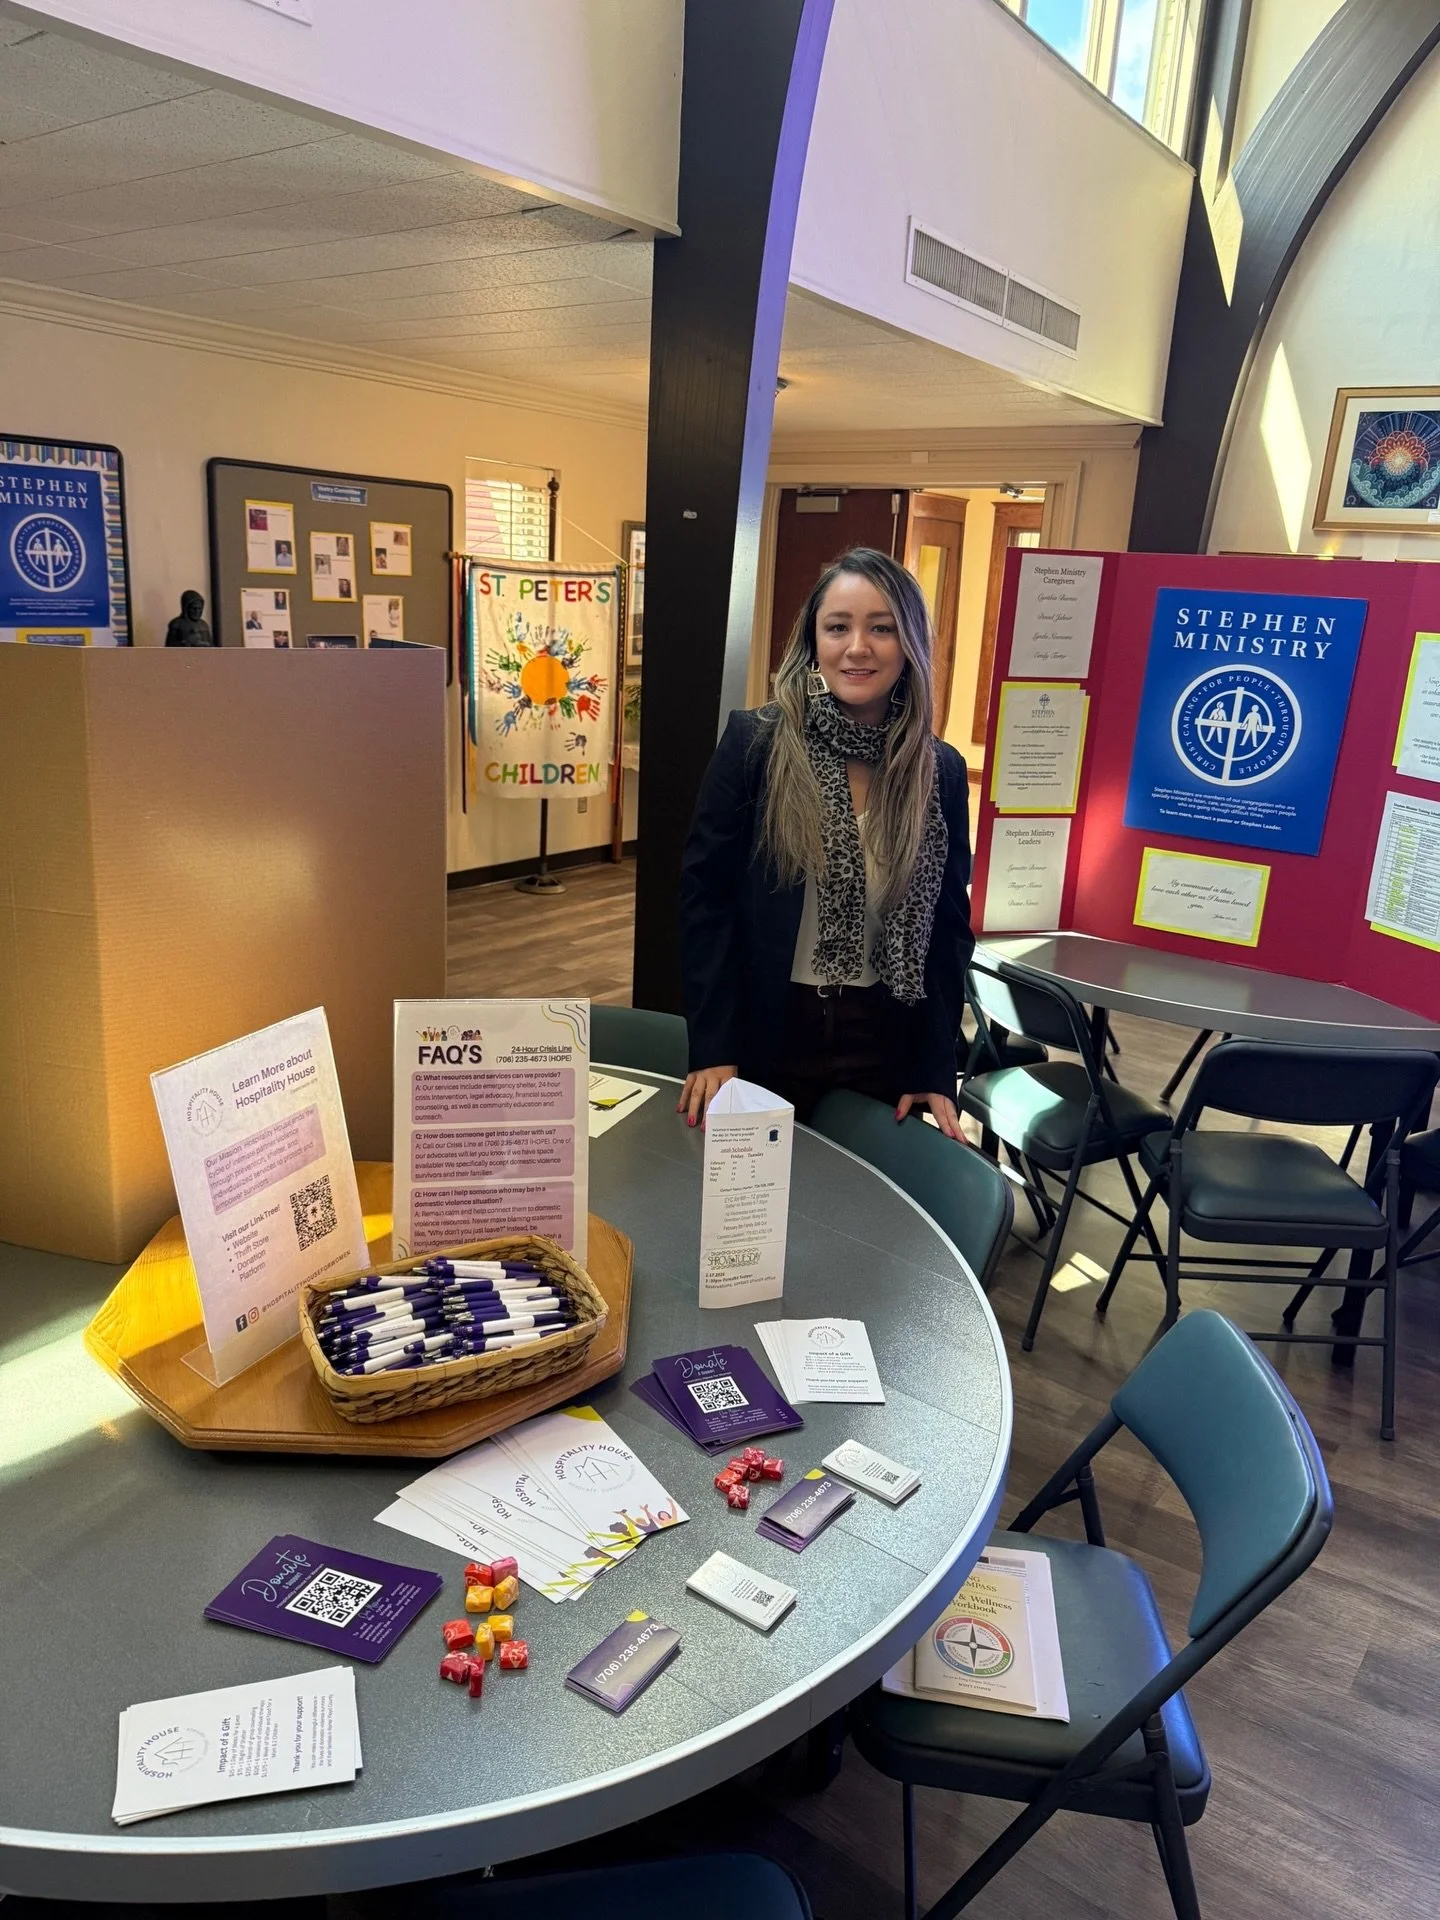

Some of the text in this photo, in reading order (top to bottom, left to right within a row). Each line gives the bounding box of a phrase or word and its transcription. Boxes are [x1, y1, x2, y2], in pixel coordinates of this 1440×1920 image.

[1034, 566, 1086, 577] Stephen Ministry
[1042, 576, 1075, 585] Caregivers
[478, 573, 612, 604] ST. PETER'S
[1176, 608, 1337, 635] STEPHEN
[1173, 631, 1332, 660] MINISTRY
[1184, 675, 1289, 773] CHRIST CARING FOR PEOPLE THROUGH PEOPLE
[484, 763, 601, 786] CHILDREN
[1153, 786, 1172, 794] Stephen
[1241, 799, 1274, 809] congregation
[1210, 806, 1230, 814] through
[1257, 807, 1277, 815] support
[1278, 810, 1296, 818] people
[1005, 829, 1029, 837] Stephen
[1240, 820, 1261, 828] Stephen
[1262, 823, 1282, 831] Leader.
[1180, 880, 1213, 891] command
[1165, 887, 1179, 895] each
[1180, 890, 1197, 898] other
[1230, 898, 1251, 907] loved
[418, 1044, 482, 1065] FAQ'S
[511, 1045, 538, 1053] 24-Hour
[538, 1045, 556, 1053] Crisis
[548, 1054, 571, 1062] (HOPE)
[231, 1047, 312, 1093] Learn More about
[235, 1077, 286, 1111] Hospitality
[286, 1063, 315, 1084] House
[186, 1087, 224, 1122] HOSPITALITY HOUSE
[453, 1189, 466, 1197] help
[472, 1197, 502, 1205] situation?
[222, 1228, 237, 1243] Visit
[237, 1222, 249, 1234] our
[232, 1228, 258, 1249] Website
[234, 1233, 269, 1260] Thrift Store
[236, 1247, 265, 1272] Donation
[735, 1252, 761, 1263] TUESDAY
[239, 1260, 265, 1282] Platform
[675, 1350, 728, 1378] Donate
[554, 1444, 633, 1480] HOSPITALITY HOUSE
[785, 1481, 832, 1525] (706) 235-4673
[242, 1549, 311, 1602] Donate
[966, 1581, 997, 1592] MPASS
[952, 1600, 997, 1615] Workbook
[970, 1595, 1013, 1610] Wellness
[595, 1623, 659, 1684] (706) 235-4673
[221, 1717, 230, 1731] Gift
[136, 1726, 179, 1778] HOSPITALITY HOUSE
[219, 1737, 228, 1746] of
[216, 1747, 227, 1772] Impact
